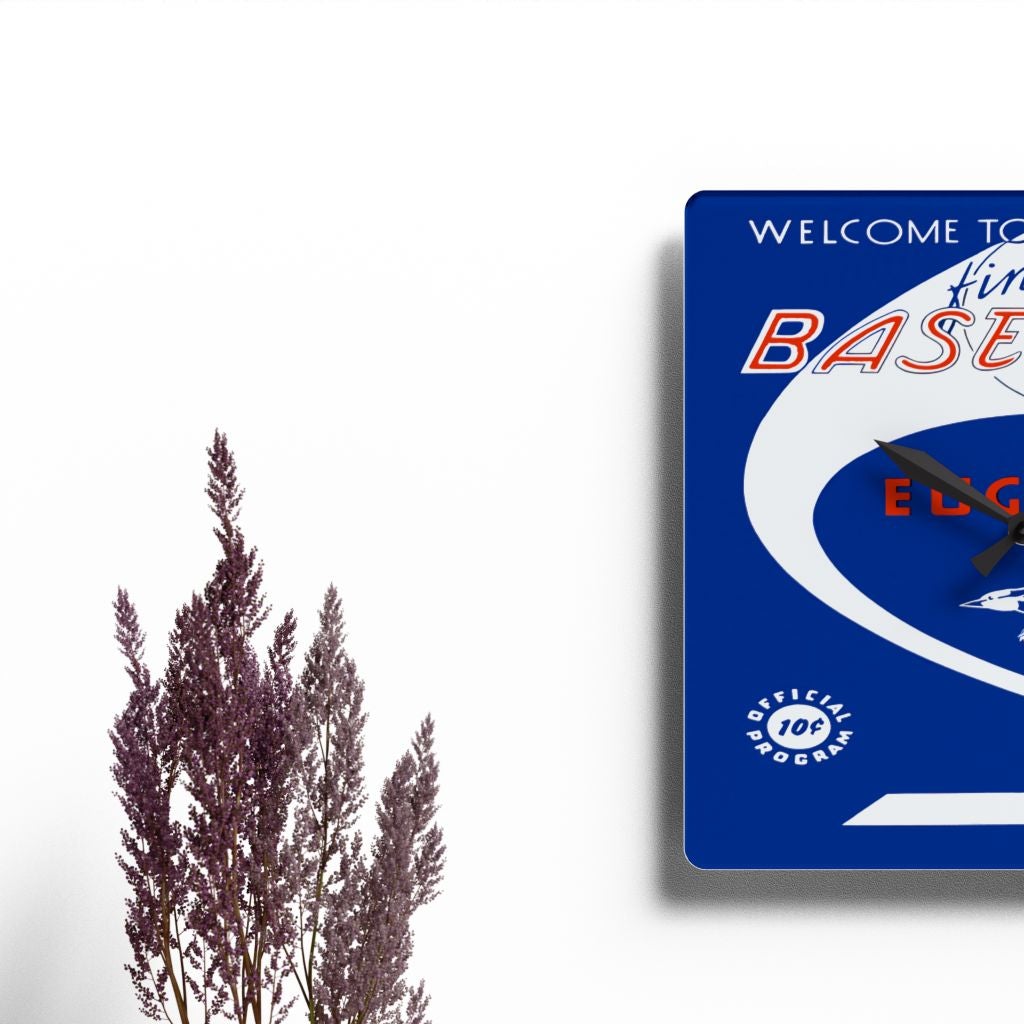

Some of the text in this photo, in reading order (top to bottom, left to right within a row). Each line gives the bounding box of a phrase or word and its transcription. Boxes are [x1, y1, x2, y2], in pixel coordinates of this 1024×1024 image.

[748, 218, 960, 246] WELCOME
[747, 688, 852, 723] OFFICIAL
[745, 729, 854, 766] PROGRAM
